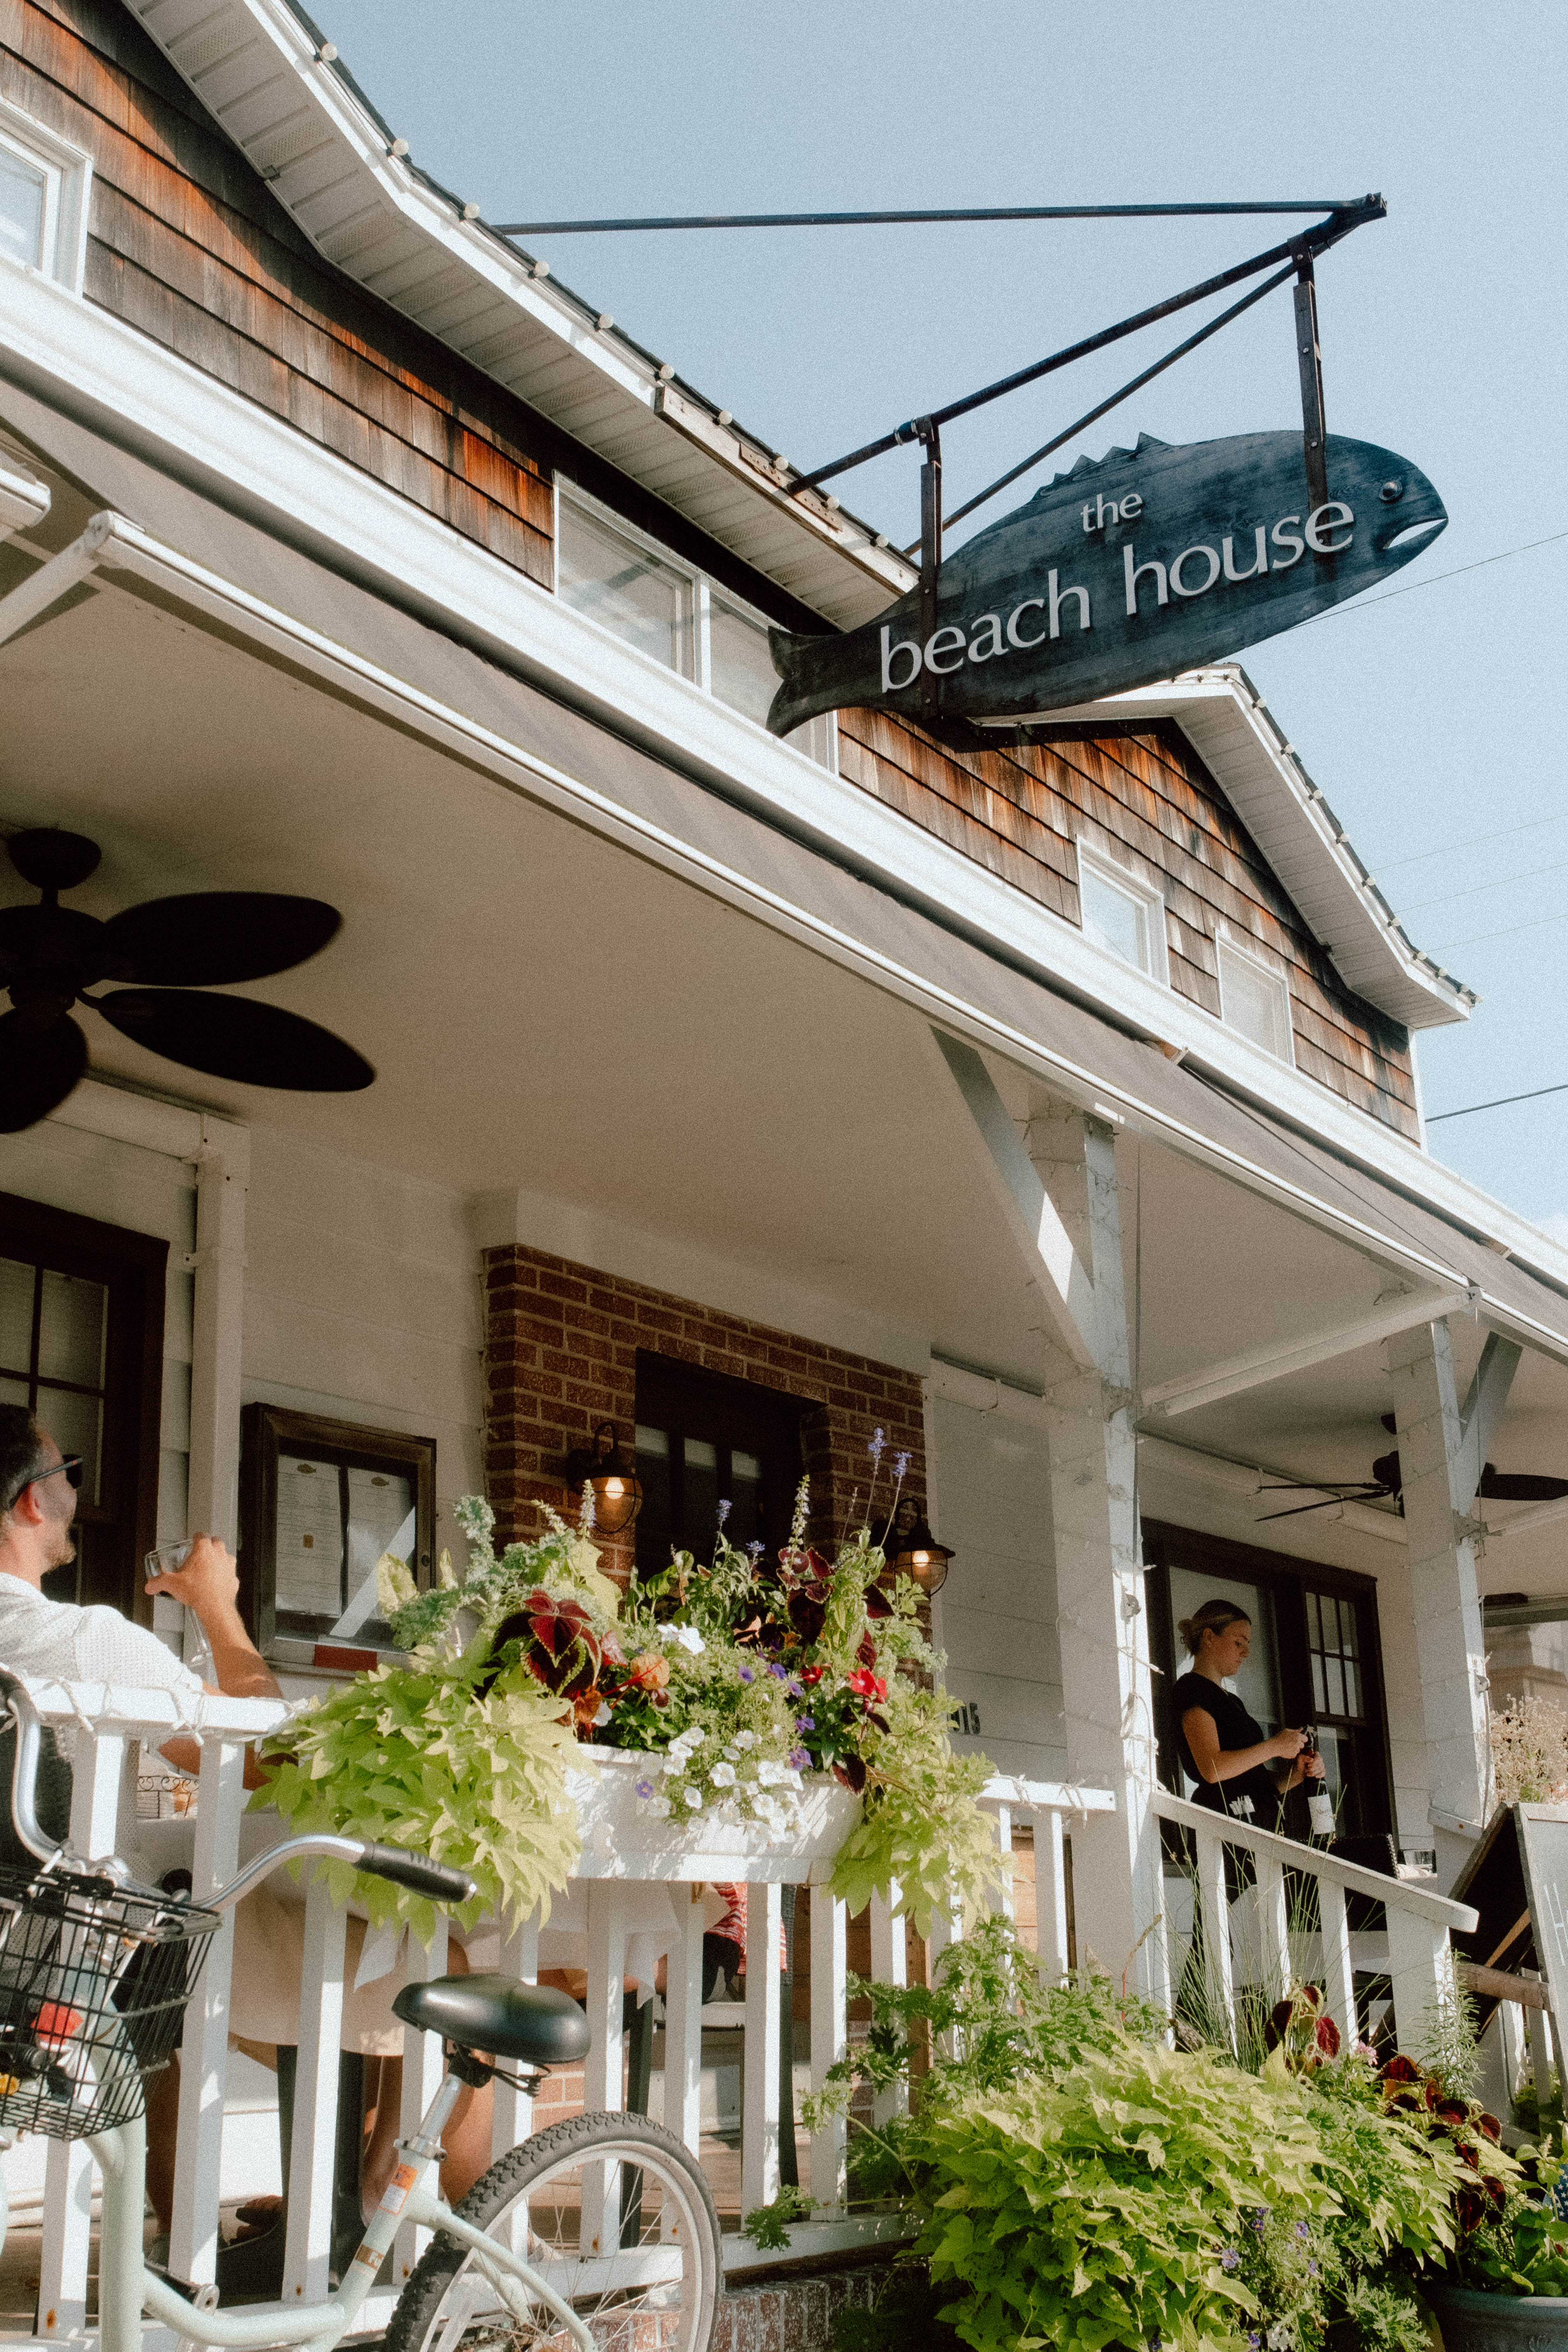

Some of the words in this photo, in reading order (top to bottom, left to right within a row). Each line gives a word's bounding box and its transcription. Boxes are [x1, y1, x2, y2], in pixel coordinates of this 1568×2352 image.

[1081, 493, 1143, 532] the
[881, 568, 1090, 693] beach
[1123, 502, 1354, 615] house
